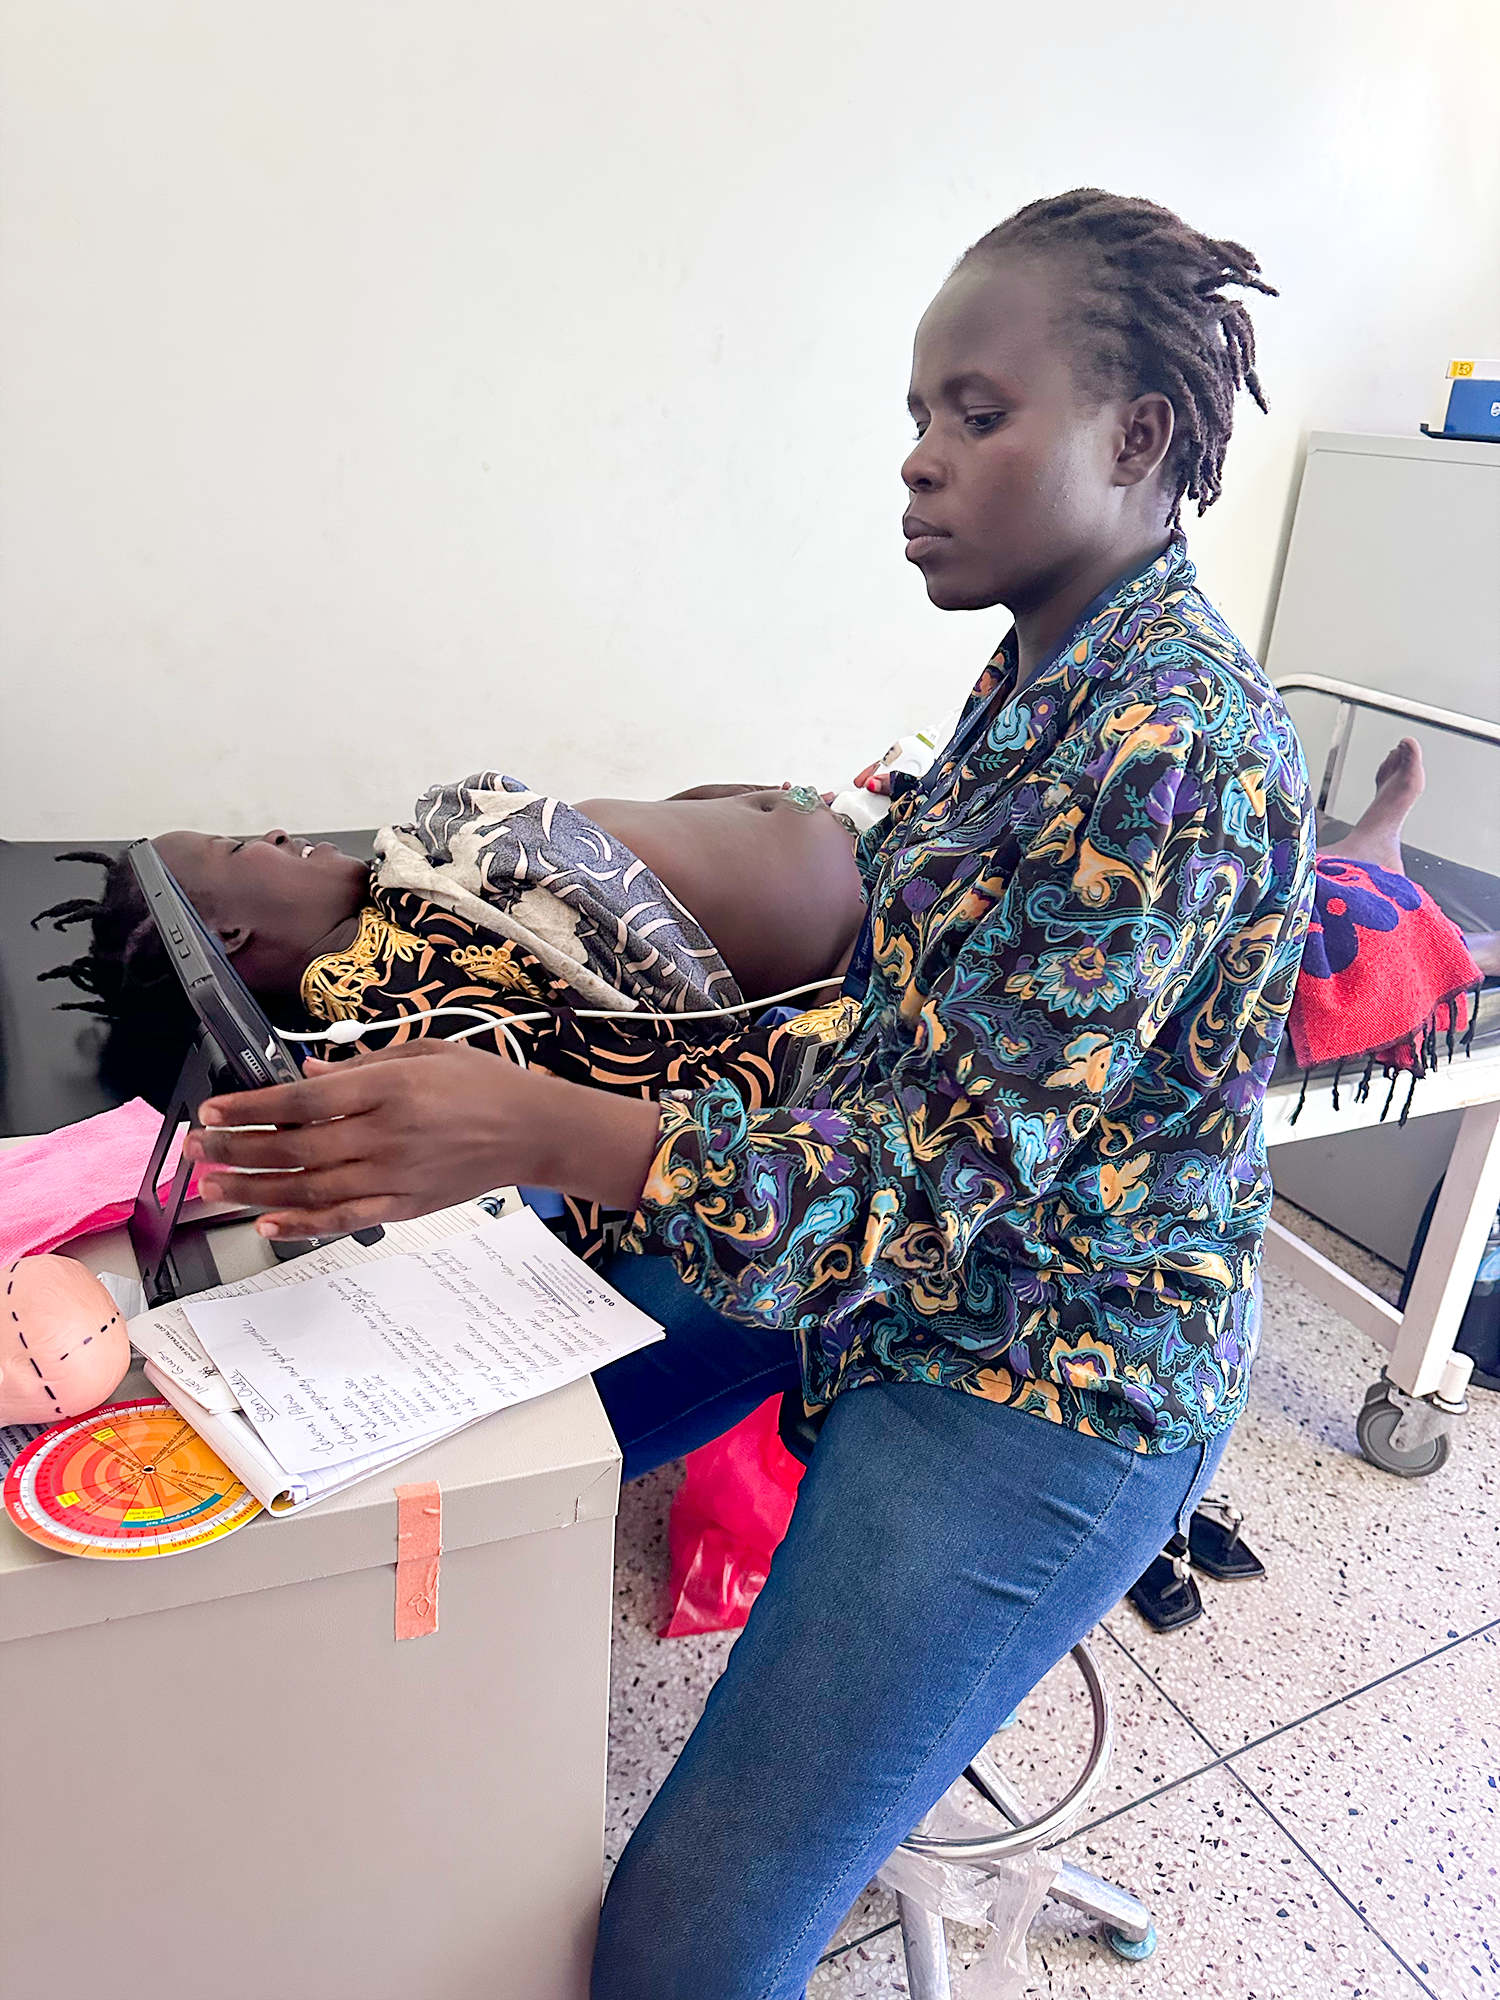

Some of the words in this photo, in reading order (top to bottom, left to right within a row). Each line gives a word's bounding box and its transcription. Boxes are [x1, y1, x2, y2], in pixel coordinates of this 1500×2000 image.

[222, 1368, 253, 1398] Order
[97, 1406, 115, 1414] JUNE
[250, 1397, 275, 1423] Scan
[43, 1429, 58, 1440] MAY
[12, 1463, 25, 1479] APRIL
[206, 1473, 224, 1481] period
[185, 1477, 215, 1491] Conception
[12, 1500, 28, 1519] MARCH
[160, 1511, 190, 1523] pregnancy
[230, 1499, 258, 1522] OVEMBER
[40, 1531, 76, 1548] FEBRUARY
[170, 1529, 214, 1547] DECEMBER
